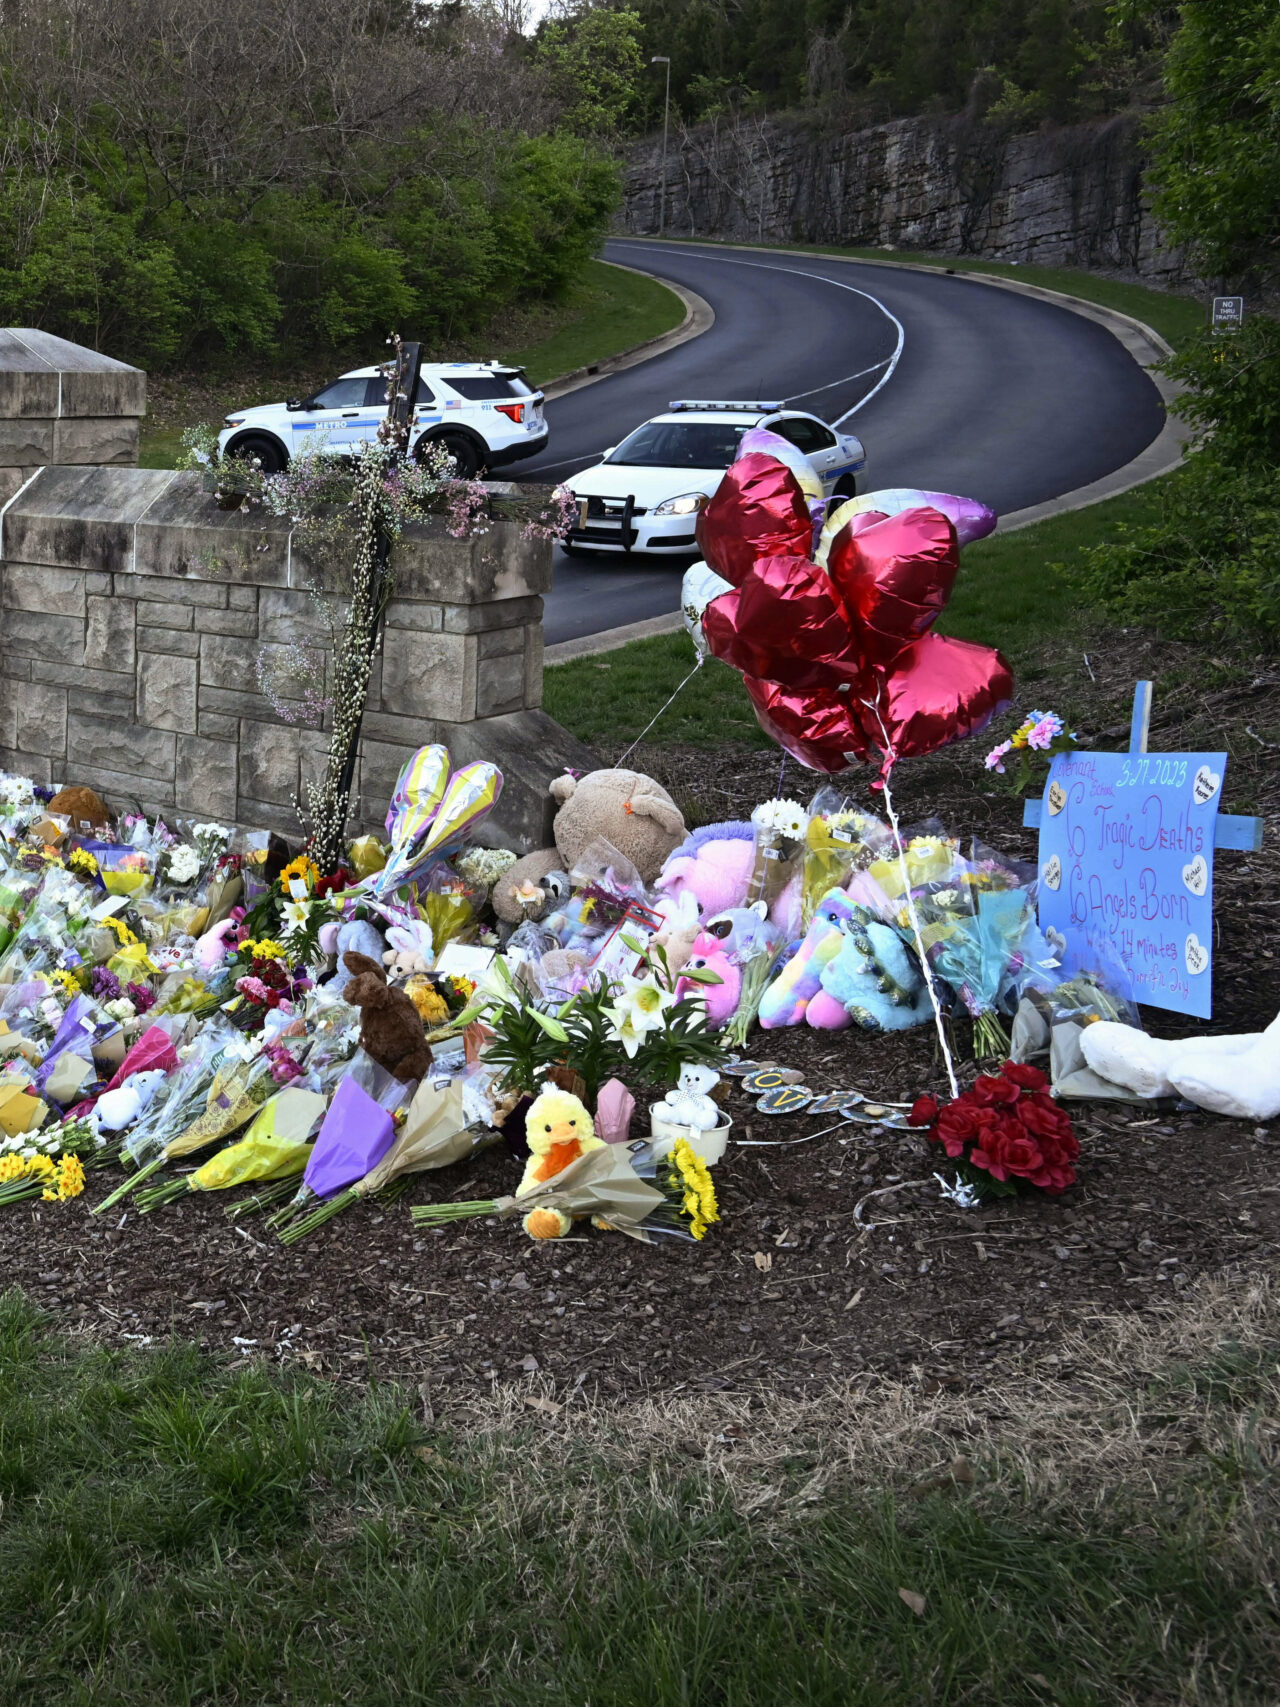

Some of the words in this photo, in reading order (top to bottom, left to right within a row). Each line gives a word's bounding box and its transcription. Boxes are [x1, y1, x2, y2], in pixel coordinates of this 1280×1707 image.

[315, 421, 348, 430] METRO
[1066, 781, 1086, 858] 6
[1094, 804, 1135, 870] Tragic
[1070, 864, 1088, 925] 6
[1087, 874, 1138, 935] Angels
[1139, 867, 1192, 926] Born
[1120, 928, 1135, 956] 14
